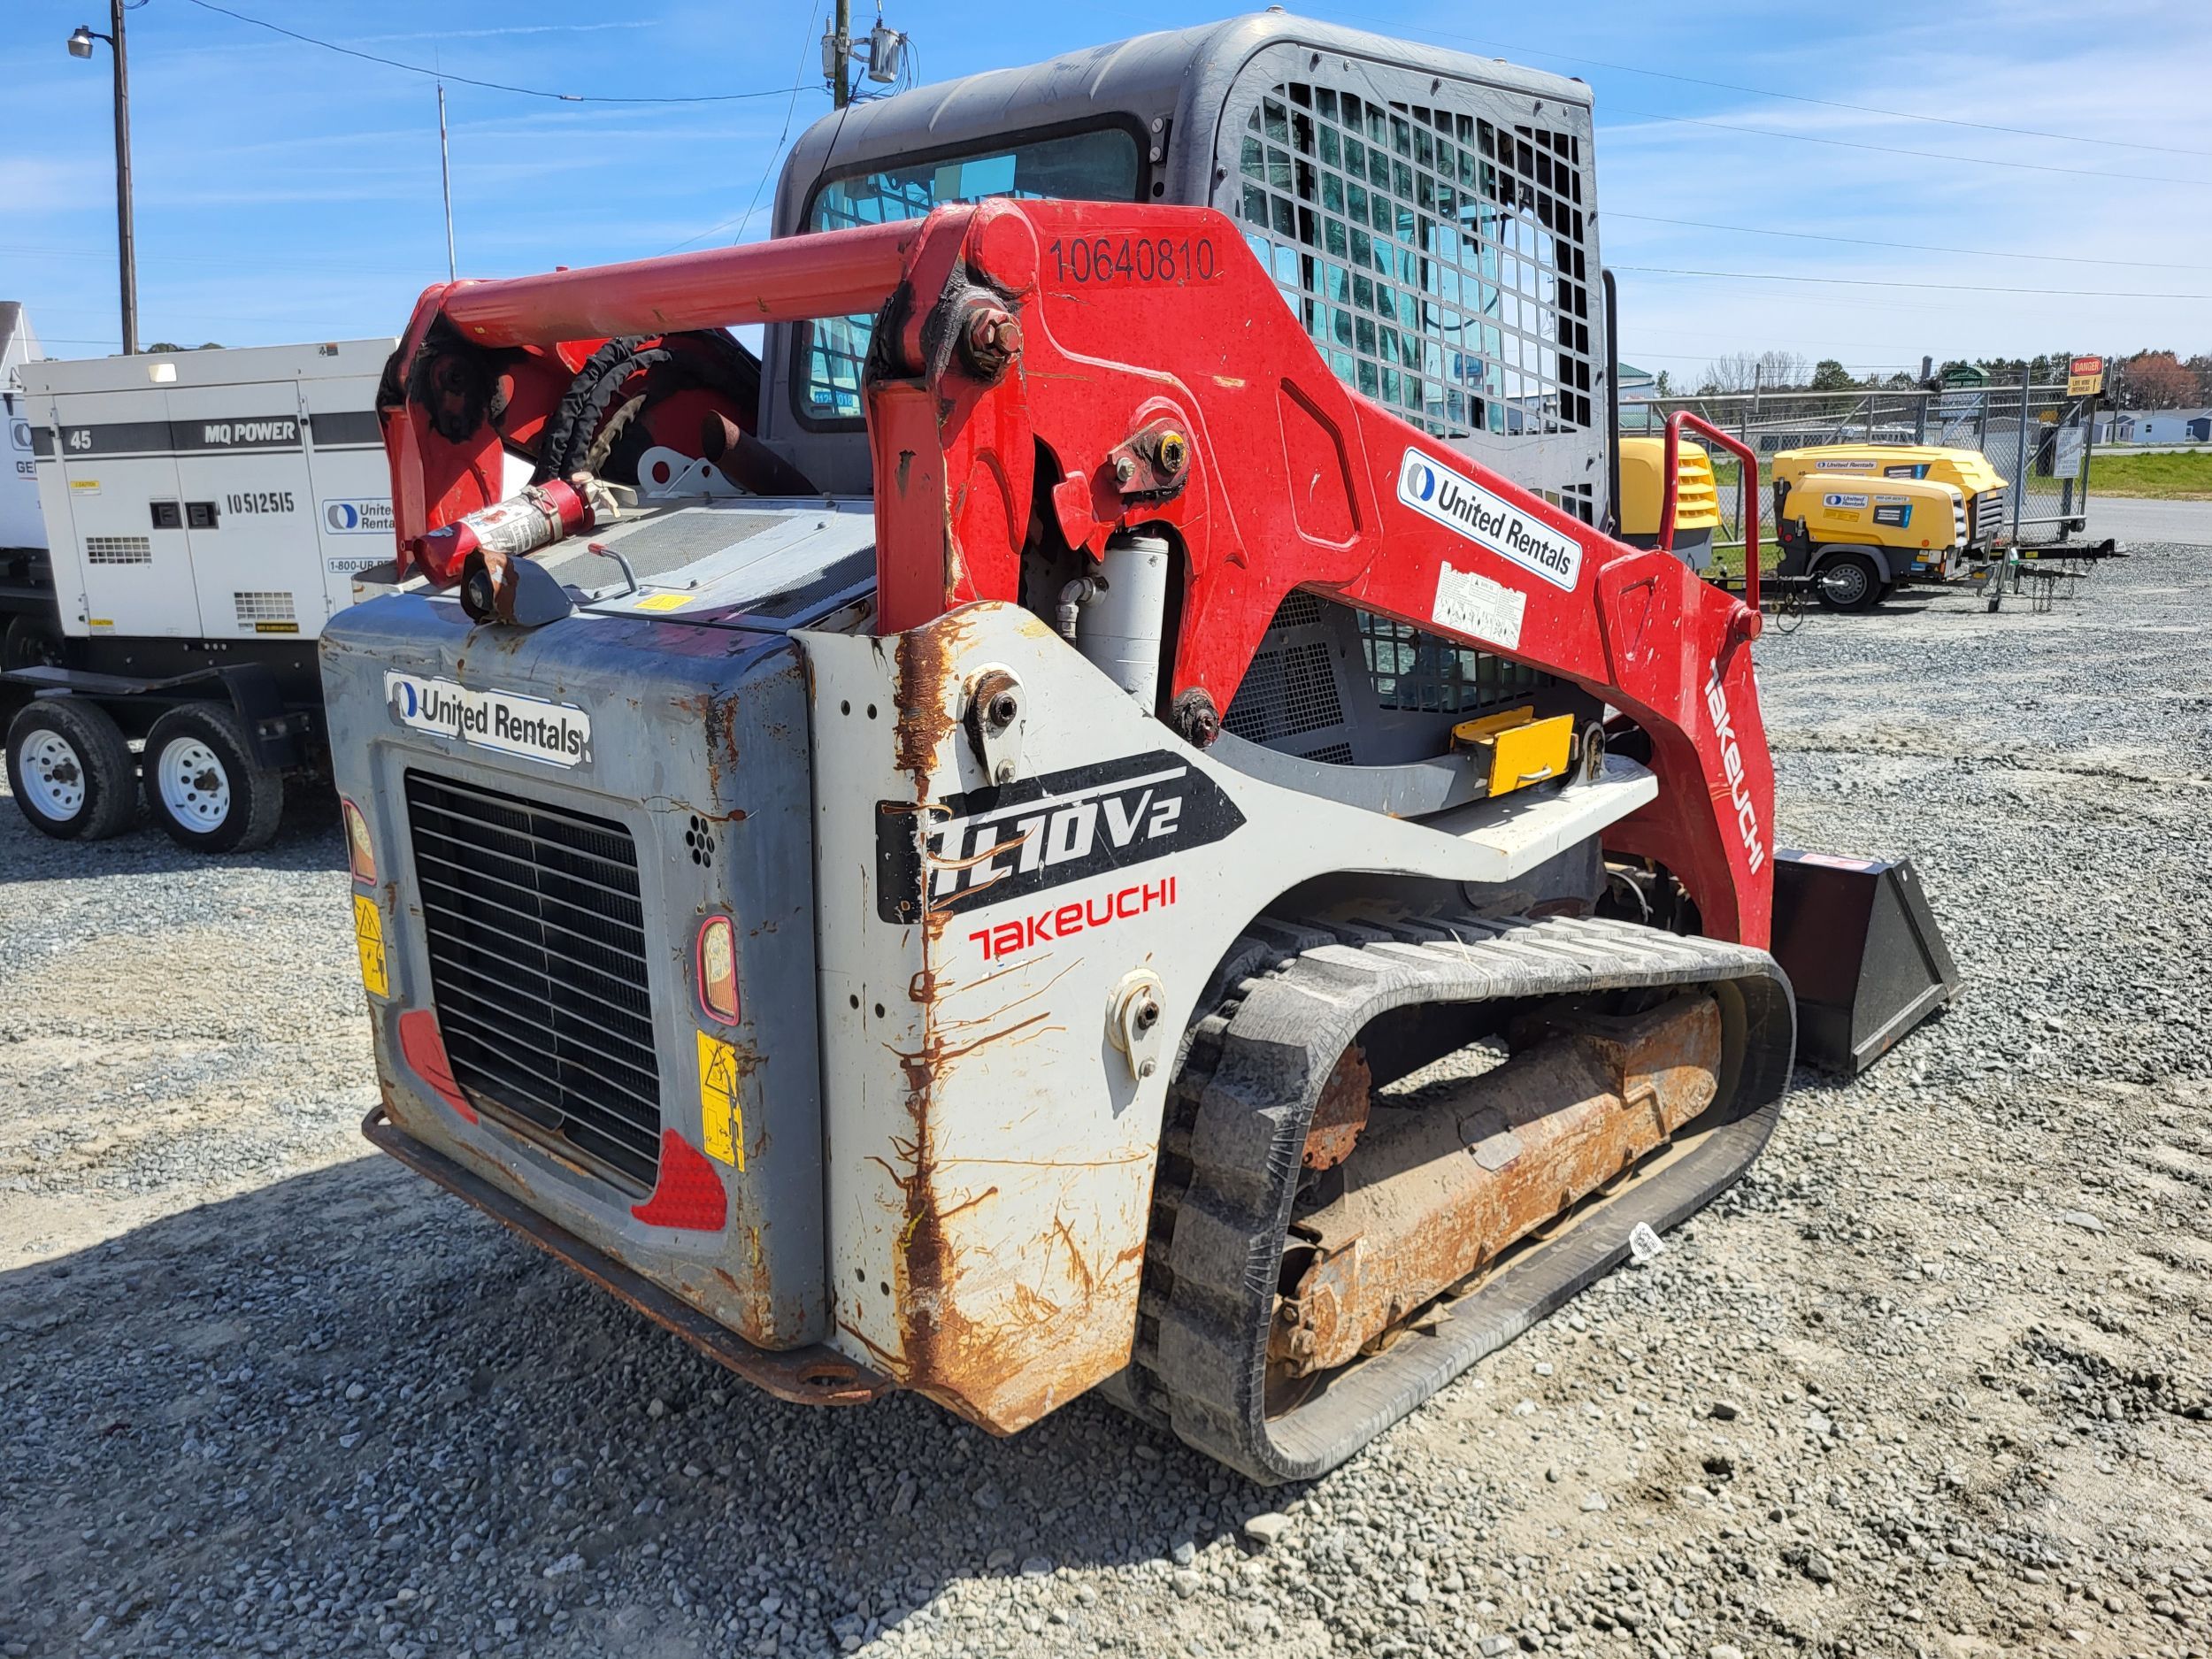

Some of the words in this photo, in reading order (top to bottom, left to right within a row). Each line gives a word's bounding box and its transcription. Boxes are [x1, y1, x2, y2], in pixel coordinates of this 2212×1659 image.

[1049, 238, 1215, 284] 10640810
[2075, 360, 2100, 373] DANGER
[815, 393, 853, 406] 112018
[70, 429, 92, 450] 45
[204, 423, 232, 446] MQ
[234, 420, 296, 442] POWER
[16, 461, 37, 473] GE
[227, 491, 295, 515] 10512515
[361, 517, 396, 529] Renta
[1438, 480, 1507, 539] United
[1505, 518, 1571, 575] Rentals
[422, 688, 488, 734] United
[495, 703, 580, 755] Rentals
[1704, 657, 1765, 876] TAKEUCHI
[969, 876, 1177, 961] TAKEUCHI
